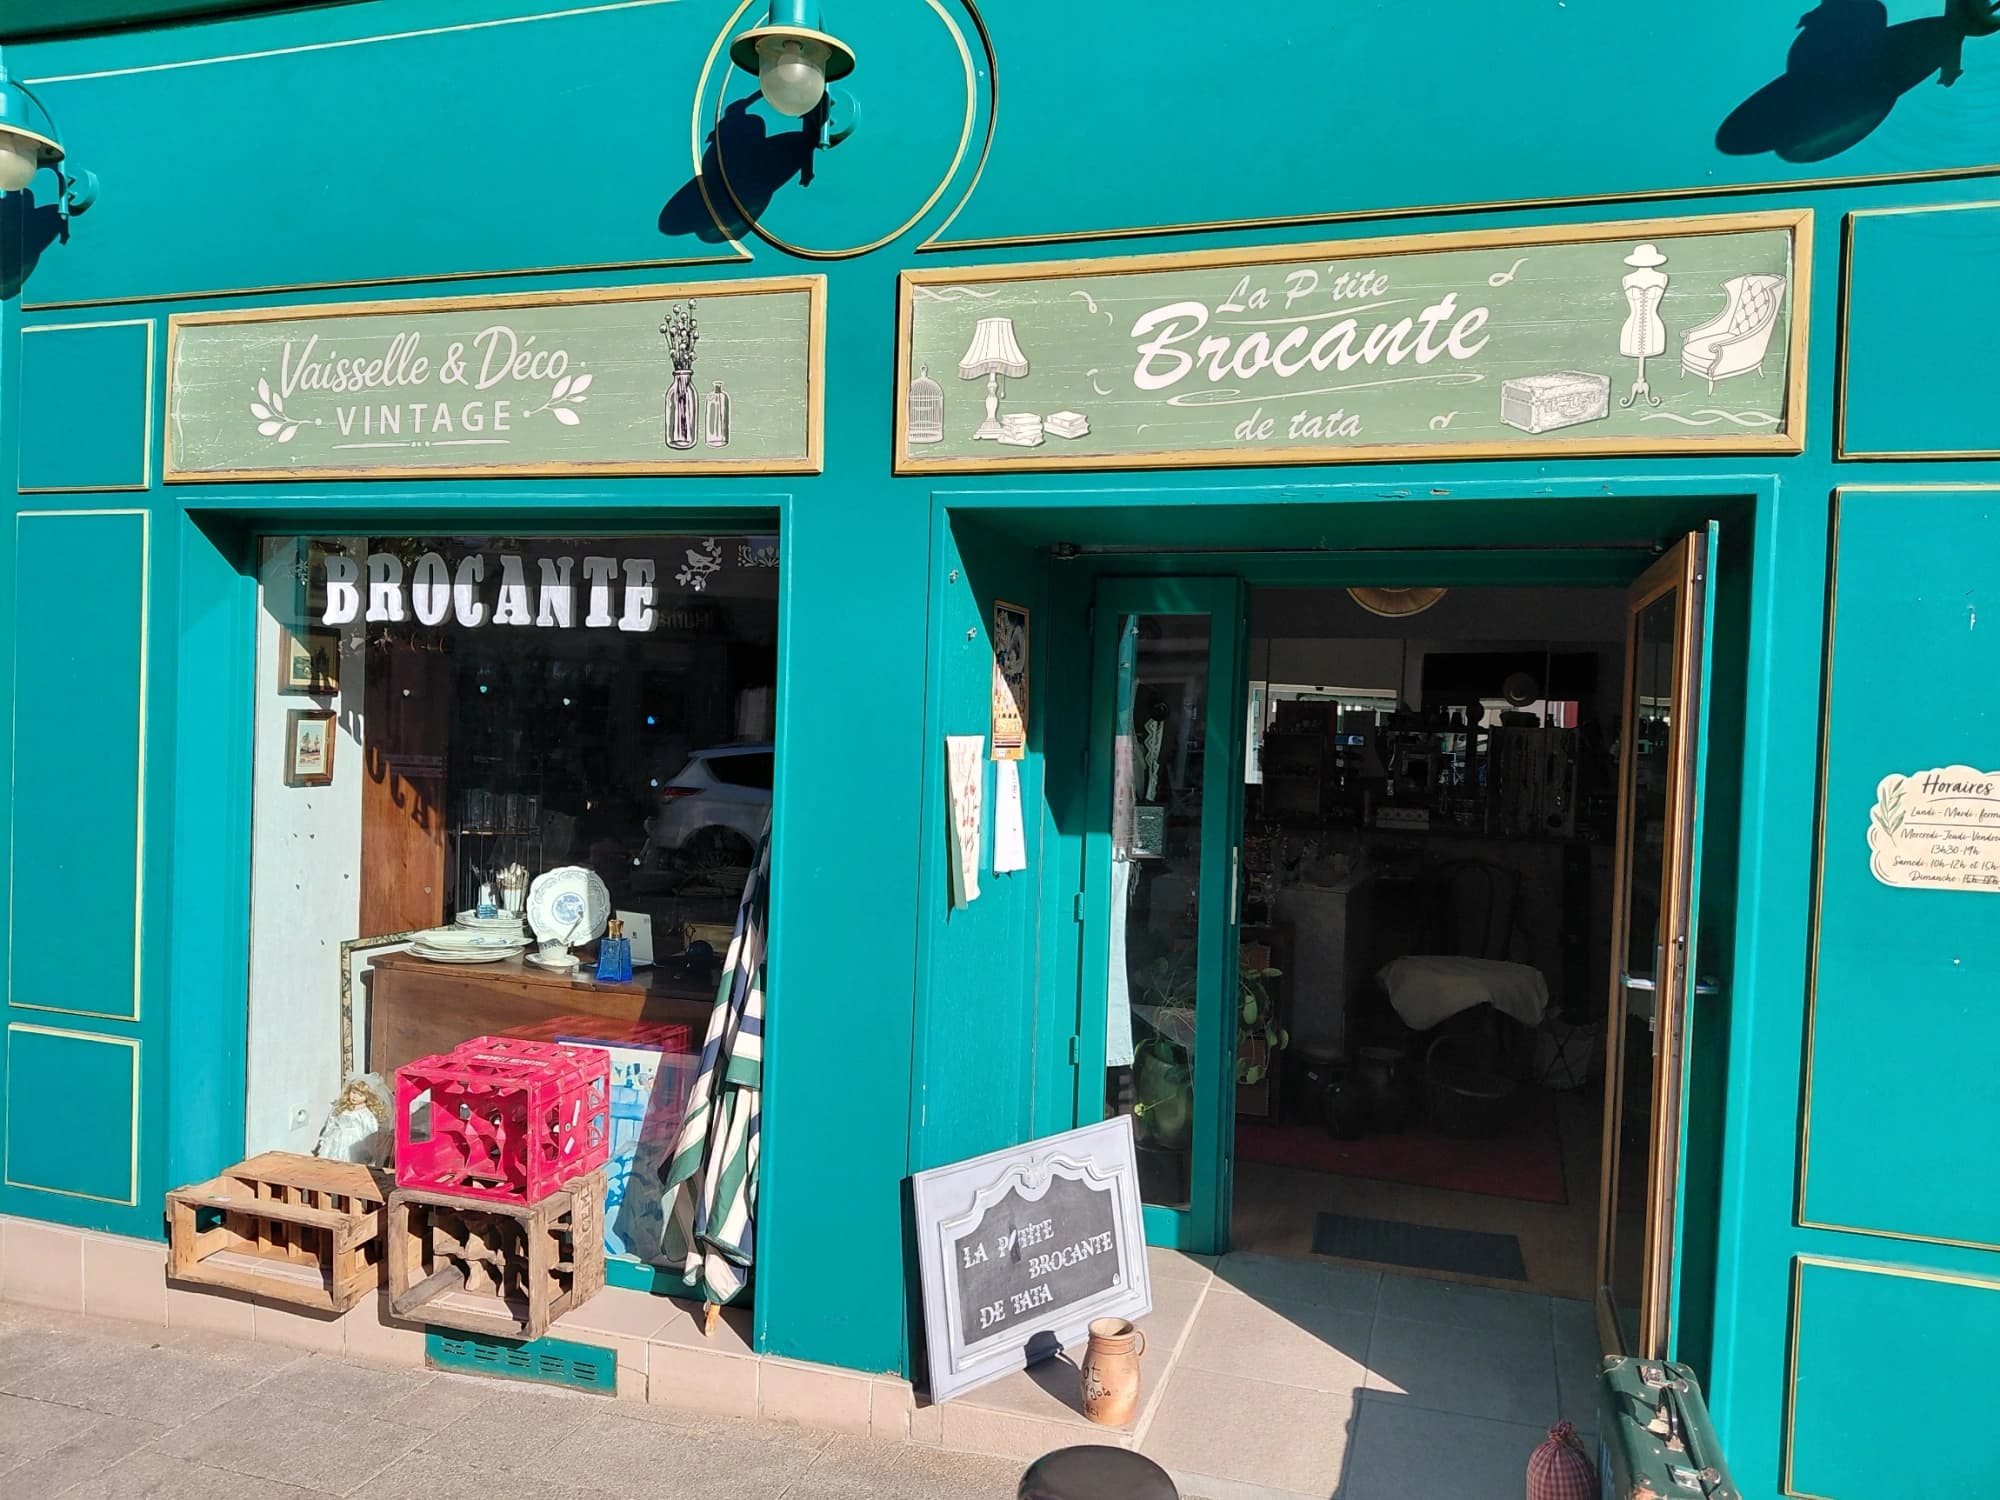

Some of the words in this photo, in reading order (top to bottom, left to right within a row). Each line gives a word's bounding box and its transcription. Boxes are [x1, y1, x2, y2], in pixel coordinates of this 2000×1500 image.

[1216, 275, 1269, 314] La
[1284, 265, 1390, 311] P'tite
[1131, 292, 1491, 390] Brocante
[278, 329, 430, 398] Vaisselle
[439, 342, 468, 385] &
[473, 325, 569, 391] Déco
[336, 400, 512, 437] VINTAGE
[1234, 406, 1274, 441] de
[1287, 408, 1364, 440] tata
[322, 551, 657, 632] BROCANTE
[1922, 774, 1994, 796] Horaires
[1910, 806, 1935, 817] Lundi
[1944, 807, 1973, 819] Mardi
[1892, 856, 1924, 867] Samedi
[1909, 871, 1956, 881] Dimanche
[963, 1242, 989, 1269] LA
[1028, 1231, 1114, 1279] BROCANTE
[980, 1300, 1006, 1329] DE
[1011, 1283, 1054, 1315] TATA
